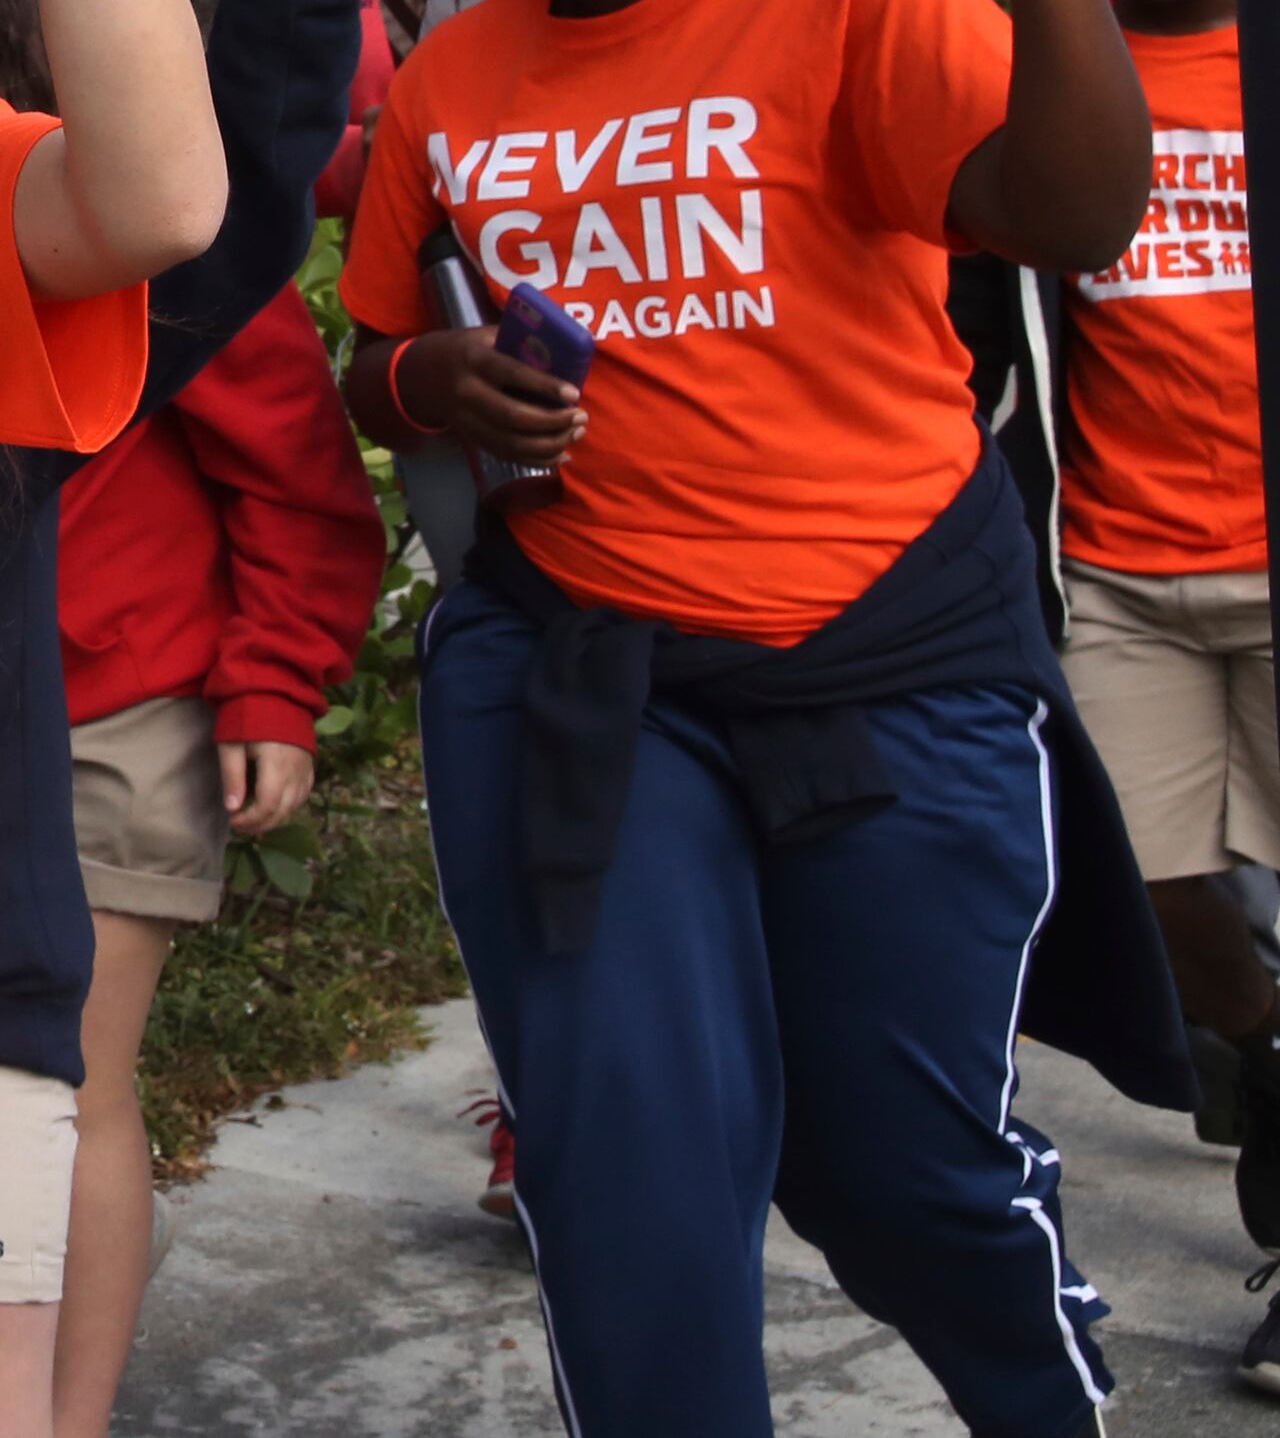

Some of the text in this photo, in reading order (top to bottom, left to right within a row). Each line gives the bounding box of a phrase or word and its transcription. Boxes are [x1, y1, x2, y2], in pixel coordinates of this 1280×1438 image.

[427, 96, 760, 205] NEVER
[1151, 153, 1247, 192] RCH
[470, 189, 765, 290] GAIN
[564, 286, 775, 341] RAGAIN
